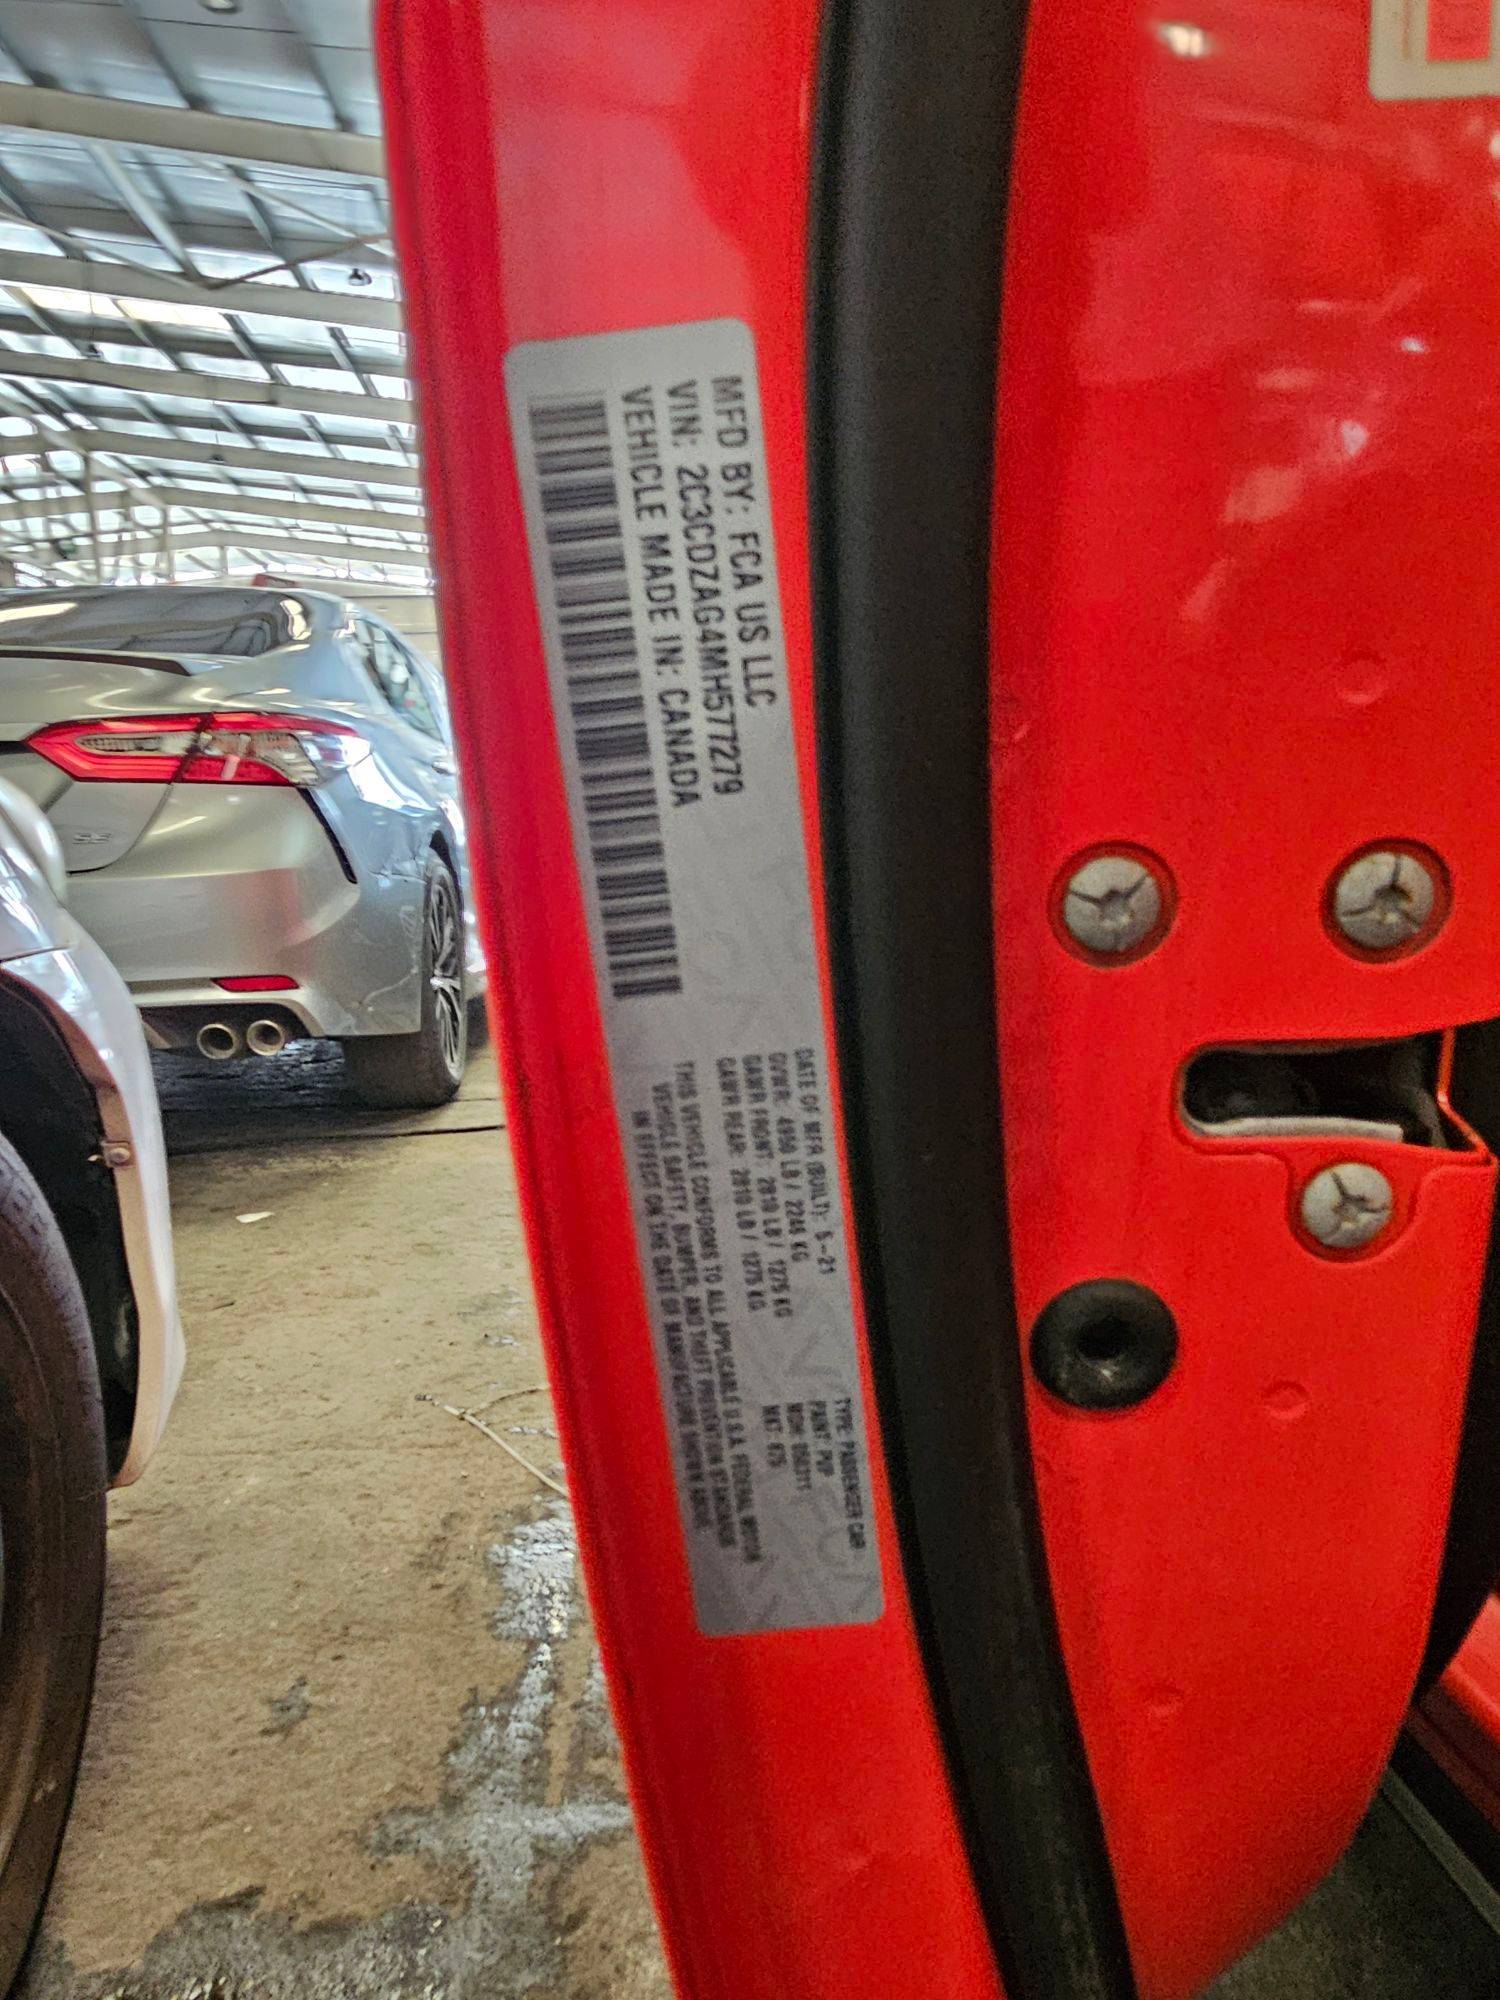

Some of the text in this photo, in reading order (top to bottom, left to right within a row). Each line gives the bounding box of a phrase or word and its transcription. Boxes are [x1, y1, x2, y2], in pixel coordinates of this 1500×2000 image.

[710, 374, 776, 709] MFD BY: FCA US LLC
[619, 384, 703, 808] VEHICLE MADE IN: CANADA
[664, 378, 744, 796] VIN: 2C3CDZAG4MH577279
[673, 1060, 698, 1100] THIS
[794, 1047, 818, 1088] DATE
[799, 1093, 820, 1114] OF
[679, 1103, 708, 1170] VEHICLE
[802, 1120, 824, 1155] MFR
[779, 1159, 801, 1180] LB
[689, 1175, 720, 1260] CONFORMS
[734, 1209, 757, 1230] LB
[761, 1216, 782, 1238] LB
[788, 1240, 810, 1263] KG
[701, 1263, 723, 1284] TO
[705, 1288, 728, 1316] ALL
[744, 1288, 767, 1312] KG
[770, 1297, 792, 1319] KG
